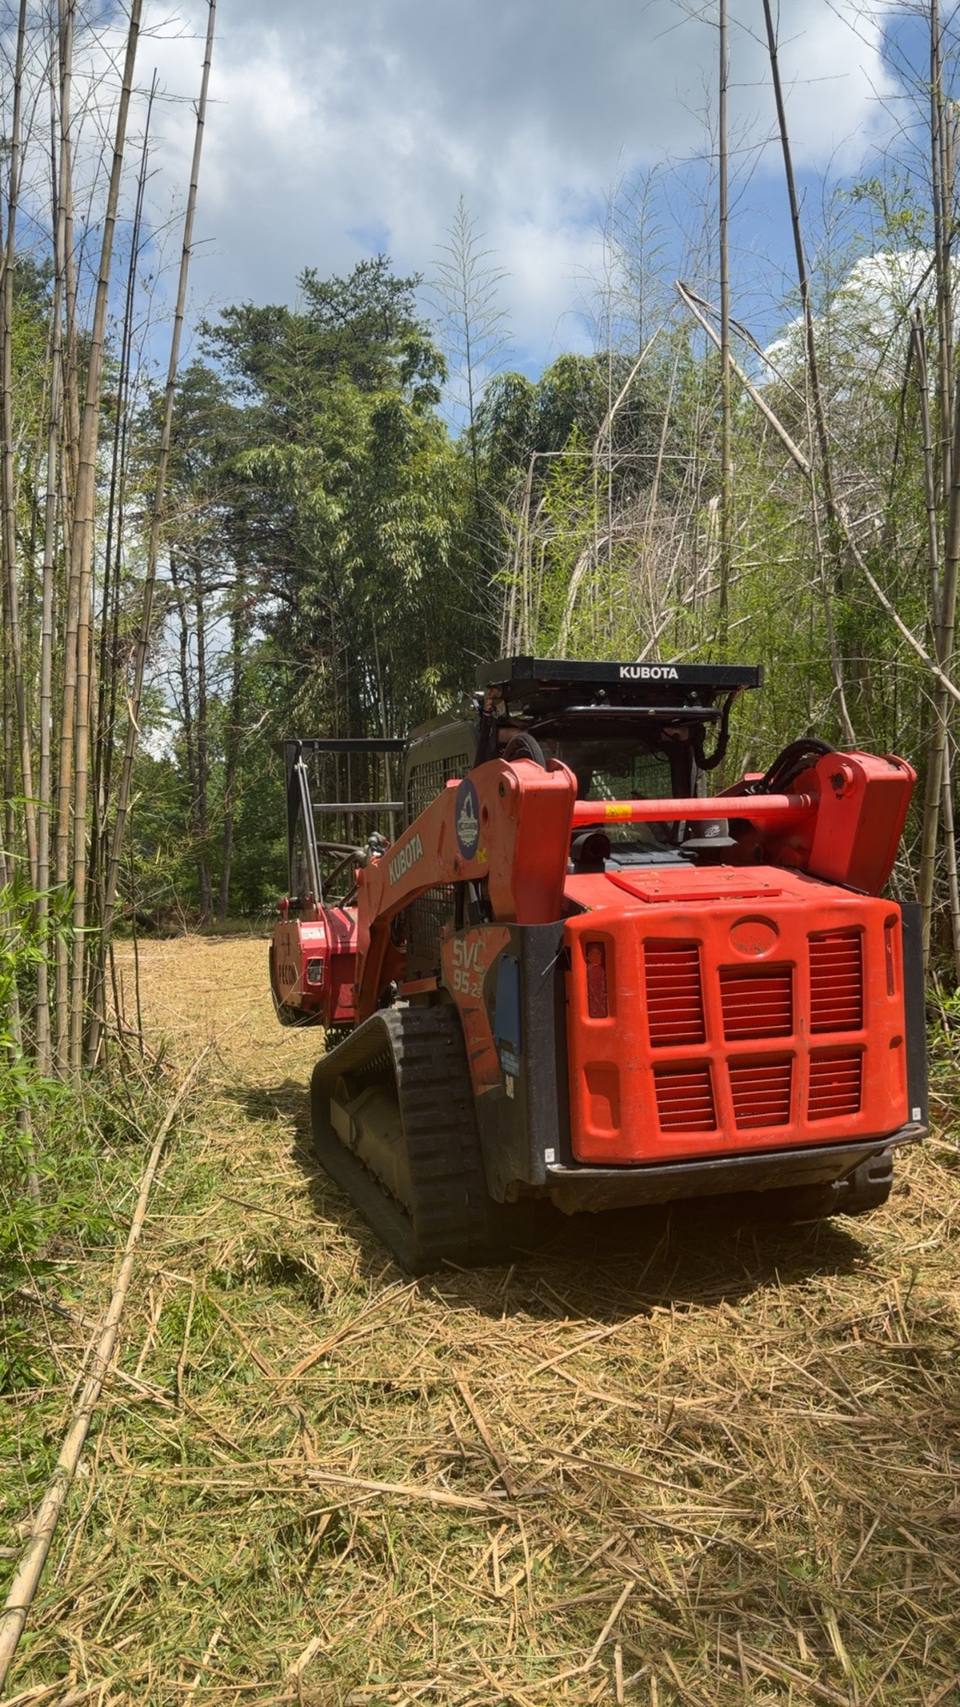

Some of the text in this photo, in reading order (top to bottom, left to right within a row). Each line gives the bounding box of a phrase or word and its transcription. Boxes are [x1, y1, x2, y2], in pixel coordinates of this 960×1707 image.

[619, 666, 679, 679] KUBOTA
[388, 833, 423, 886] KUBOTA
[452, 939, 485, 974] SVC
